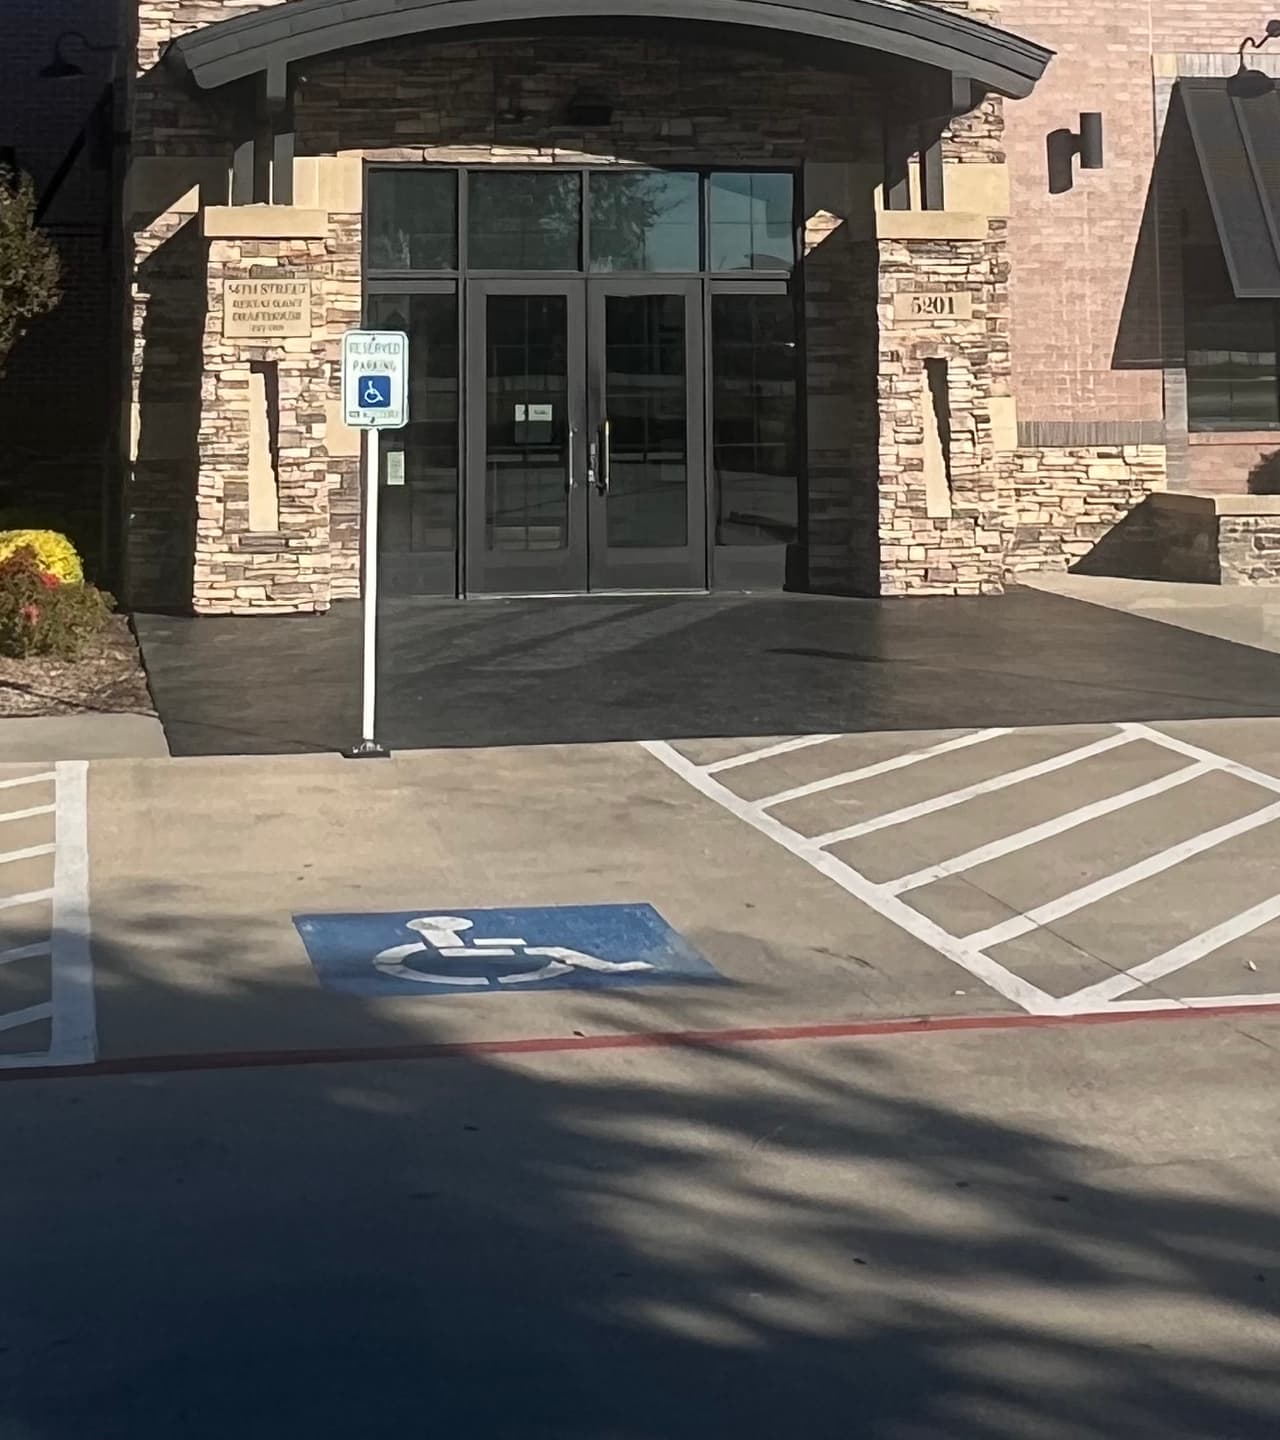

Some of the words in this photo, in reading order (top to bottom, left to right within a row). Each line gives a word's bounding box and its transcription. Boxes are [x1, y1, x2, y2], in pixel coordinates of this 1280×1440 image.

[260, 283, 308, 295] STREET
[911, 296, 955, 315] 5201
[349, 342, 401, 355] RESERVED
